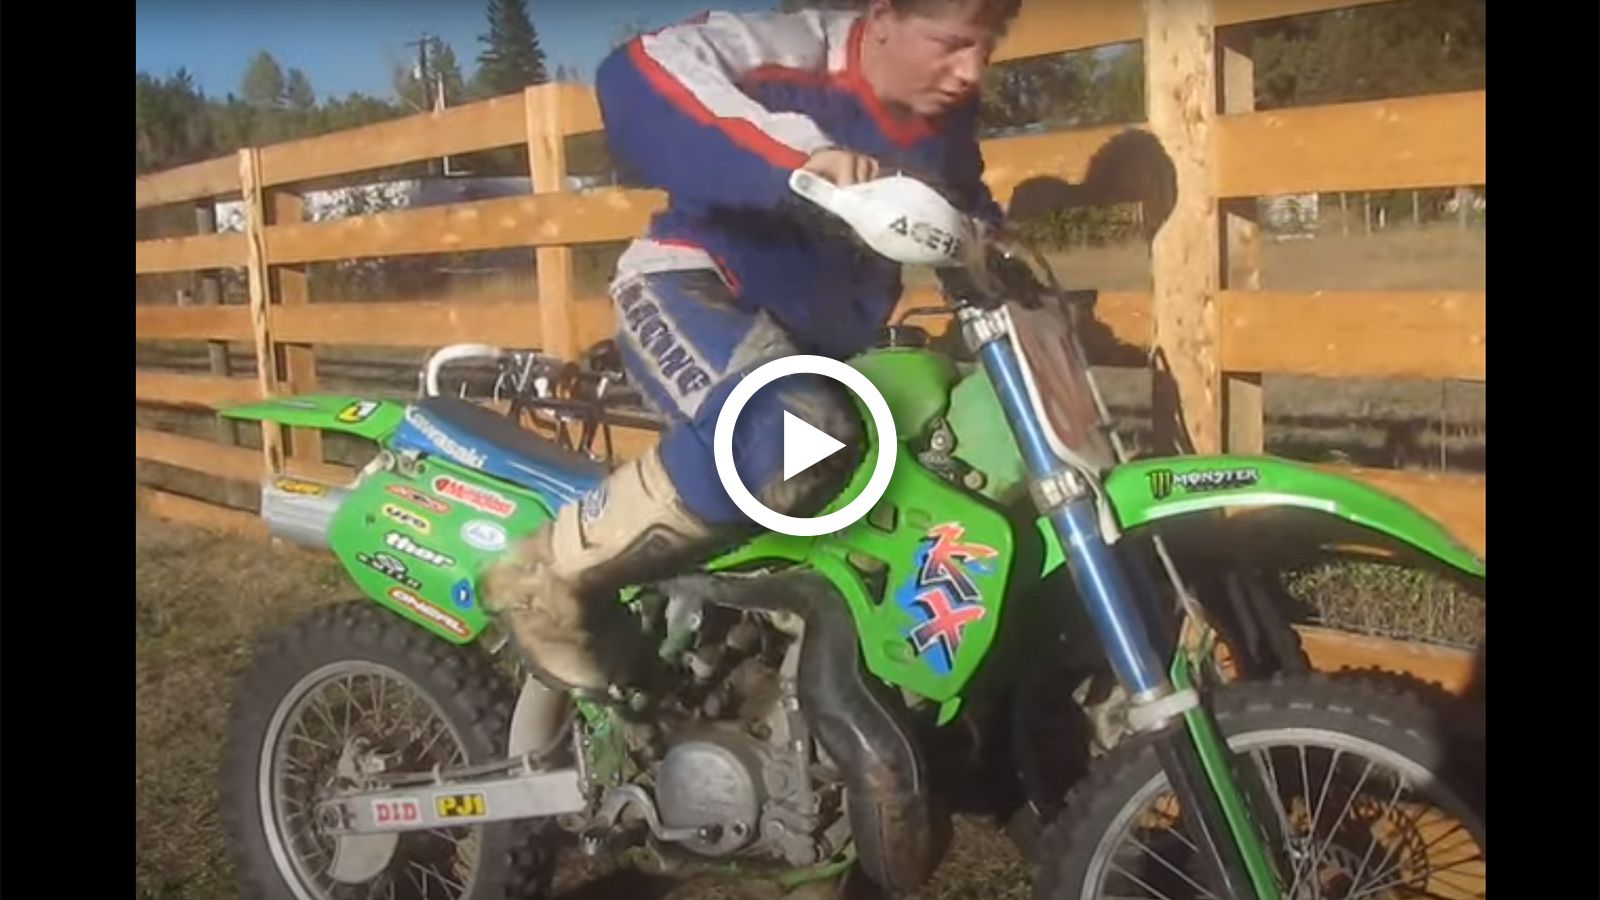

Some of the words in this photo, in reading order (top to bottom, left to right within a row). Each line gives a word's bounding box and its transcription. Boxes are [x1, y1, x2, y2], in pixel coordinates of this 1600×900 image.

[405, 404, 488, 469] Kawasaki
[1172, 468, 1259, 487] MONSTER
[907, 522, 998, 669] KX
[376, 802, 418, 823] DID
